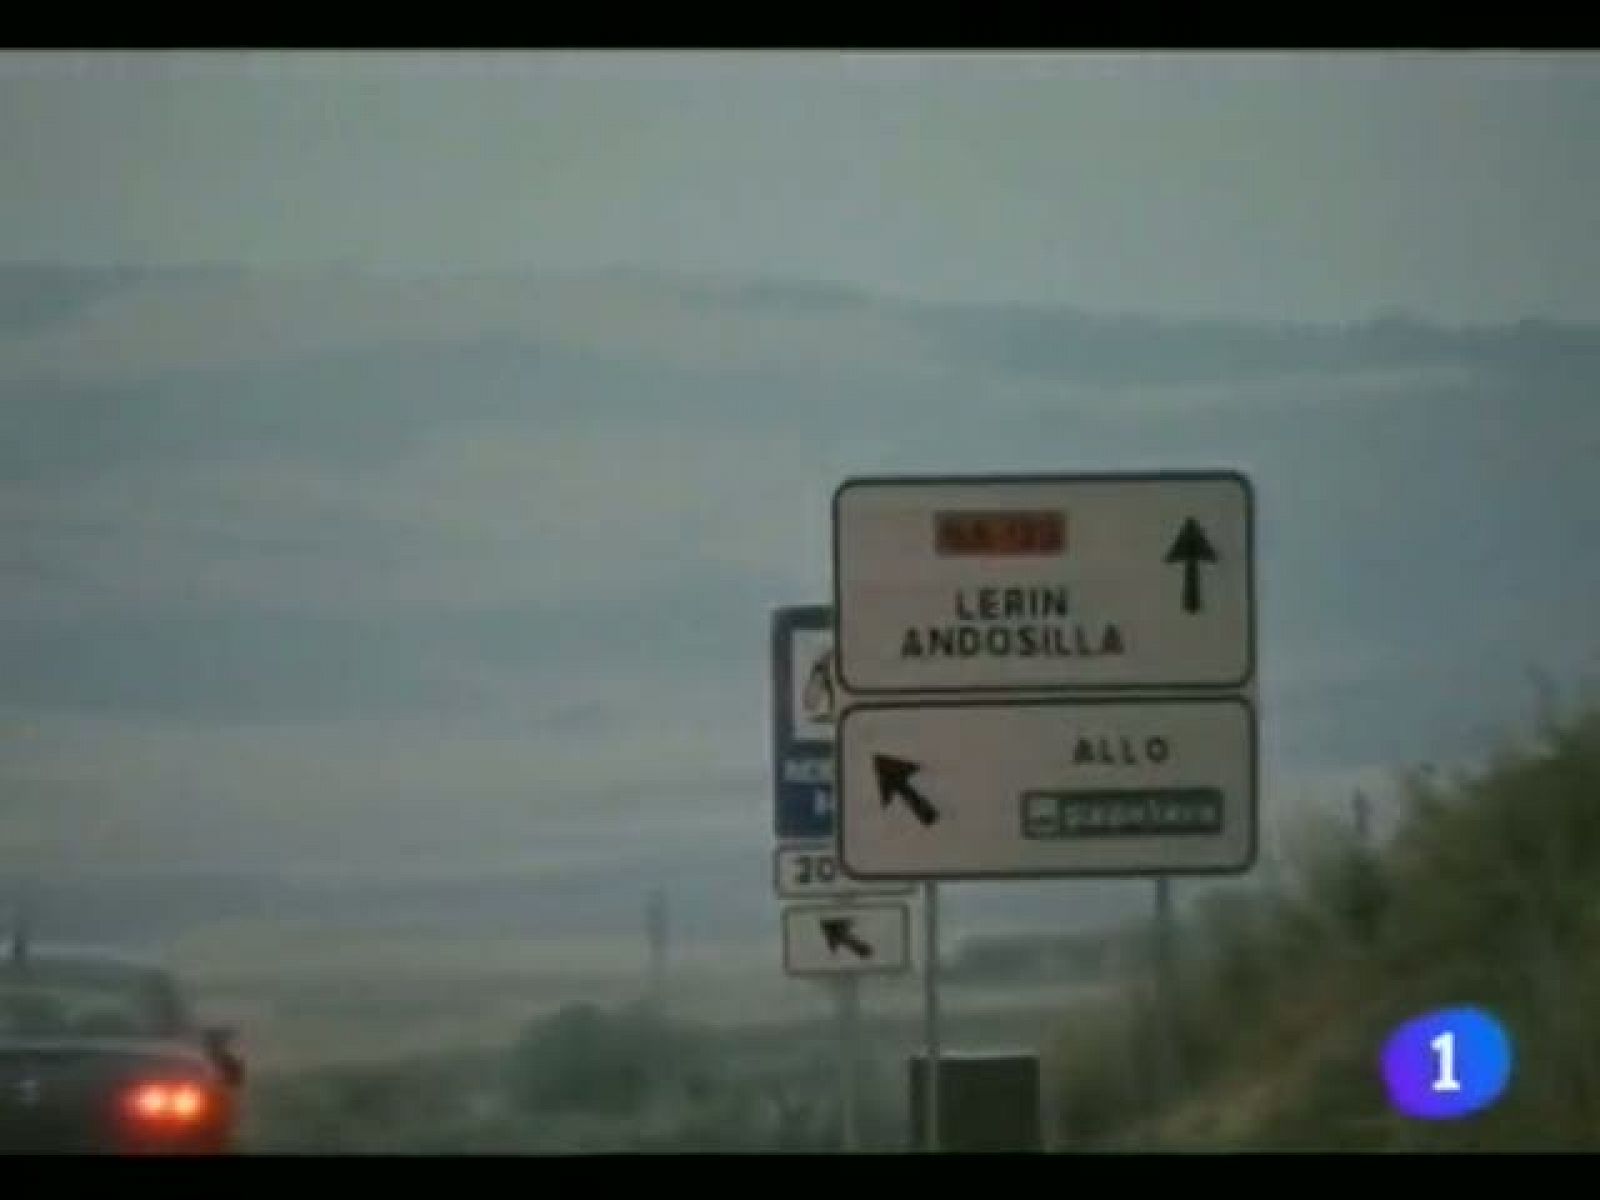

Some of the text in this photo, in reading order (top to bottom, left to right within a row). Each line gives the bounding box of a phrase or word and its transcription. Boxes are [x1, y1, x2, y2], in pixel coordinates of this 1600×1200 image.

[954, 586, 1069, 620] LERIN
[901, 624, 1124, 657] ANDOSILLA
[1073, 736, 1169, 765] ALLO
